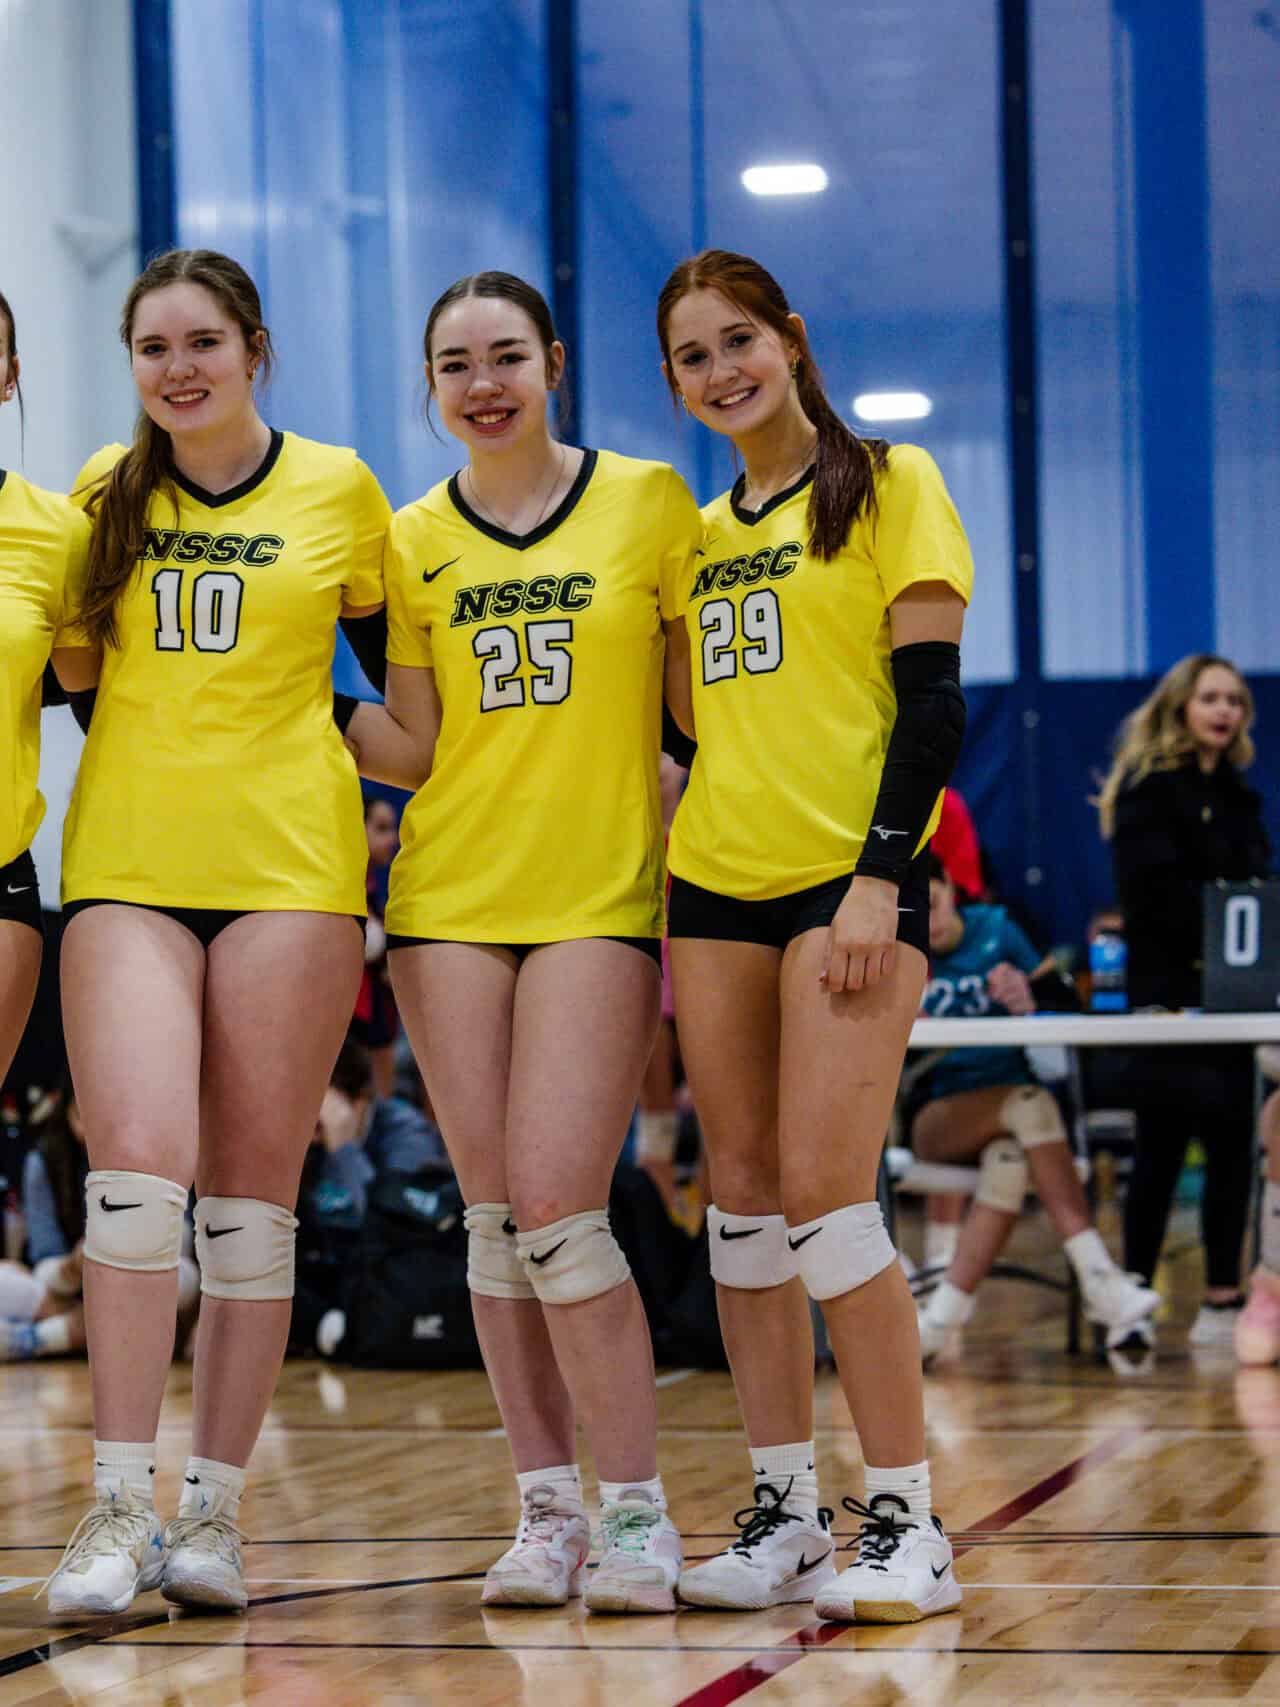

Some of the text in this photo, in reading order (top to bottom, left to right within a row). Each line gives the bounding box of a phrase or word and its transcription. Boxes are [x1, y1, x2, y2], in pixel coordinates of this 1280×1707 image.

[136, 528, 284, 567] NSSC
[688, 541, 803, 602] NSSC
[151, 568, 244, 653] 10
[450, 572, 596, 627] NSSC
[472, 619, 573, 713] 25
[699, 588, 783, 685] 29
[1224, 896, 1259, 967] 0
